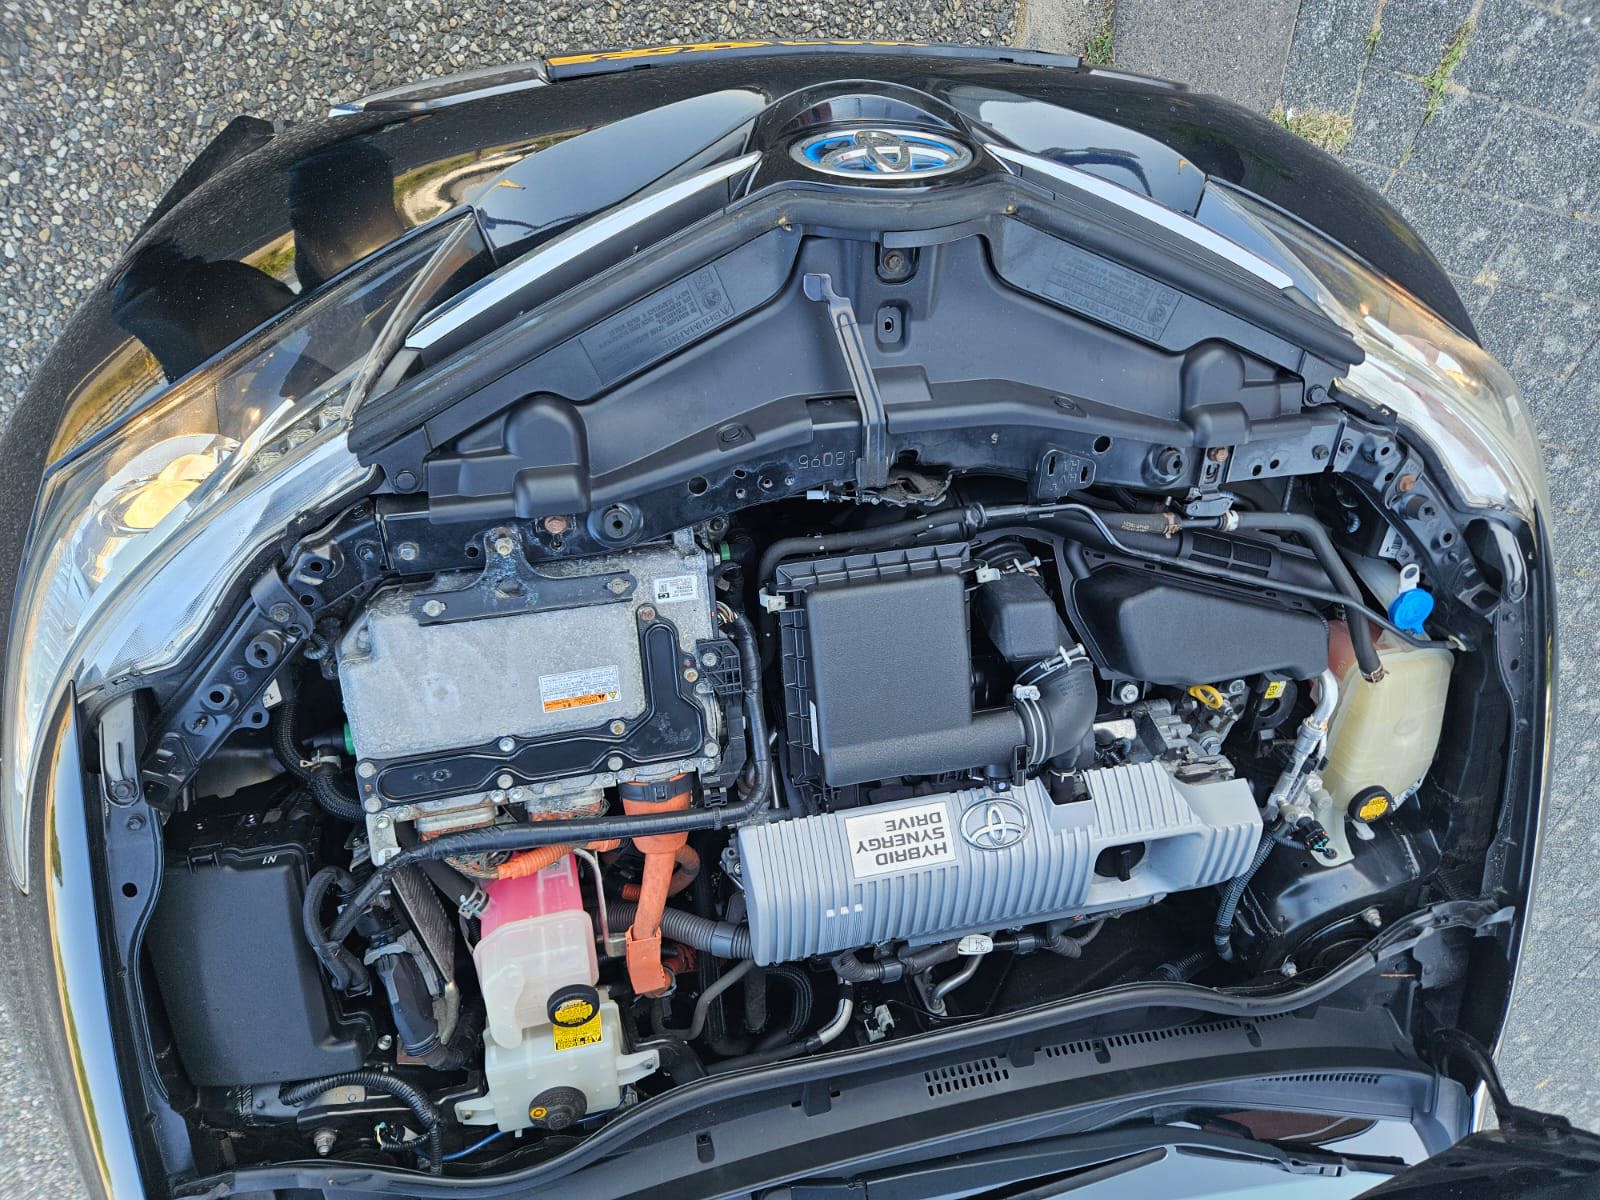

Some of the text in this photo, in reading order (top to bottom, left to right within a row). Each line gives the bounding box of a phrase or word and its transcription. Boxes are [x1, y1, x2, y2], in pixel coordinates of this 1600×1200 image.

[799, 450, 855, 469] 18095
[884, 812, 942, 832] DRIVE
[856, 826, 945, 854] SYNERGY
[875, 842, 948, 866] HYBRID
